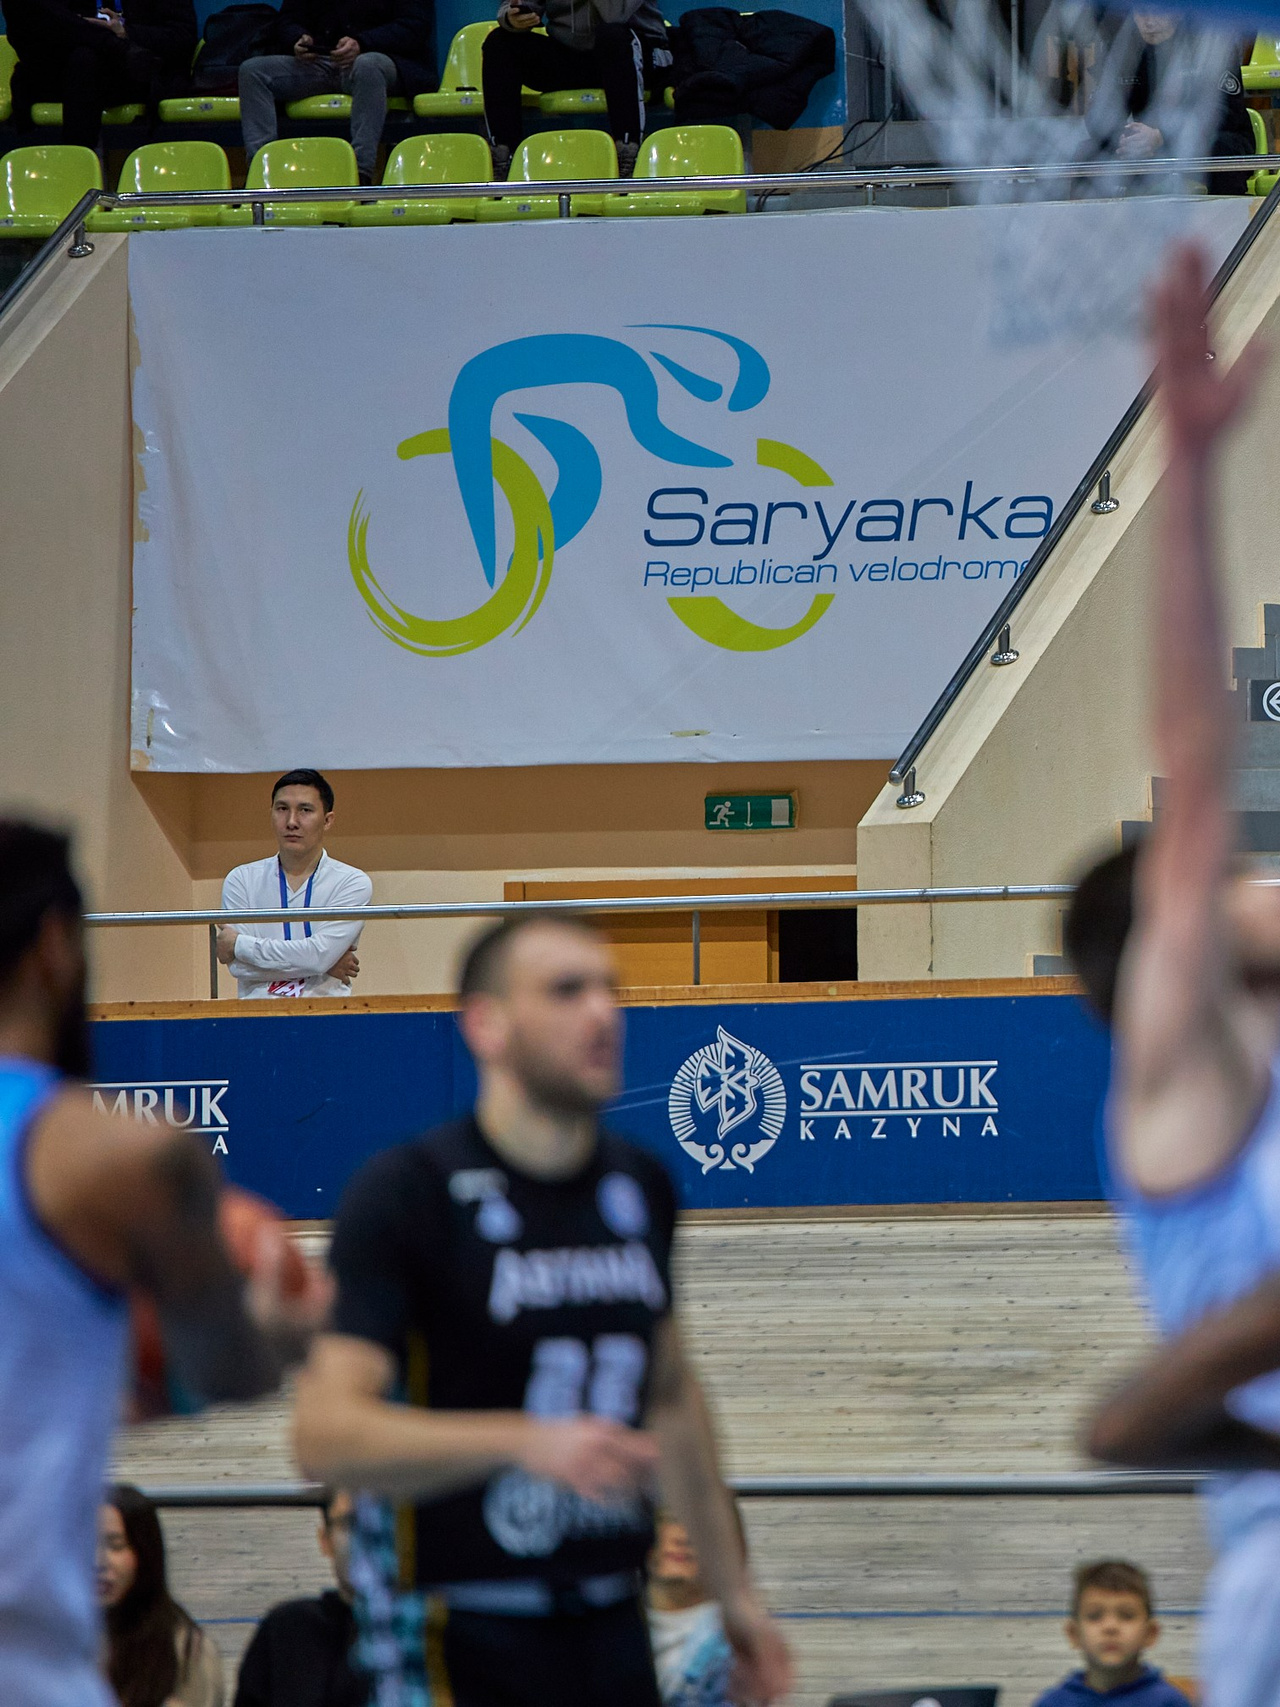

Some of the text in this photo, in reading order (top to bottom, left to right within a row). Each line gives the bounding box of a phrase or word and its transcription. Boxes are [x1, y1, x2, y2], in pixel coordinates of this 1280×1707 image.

[643, 480, 1054, 561] Saryarka
[643, 558, 838, 593] Republican
[92, 1086, 229, 1128] MRUK
[800, 1067, 998, 1111] SAMRUK
[800, 1115, 999, 1141] KAZYNA
